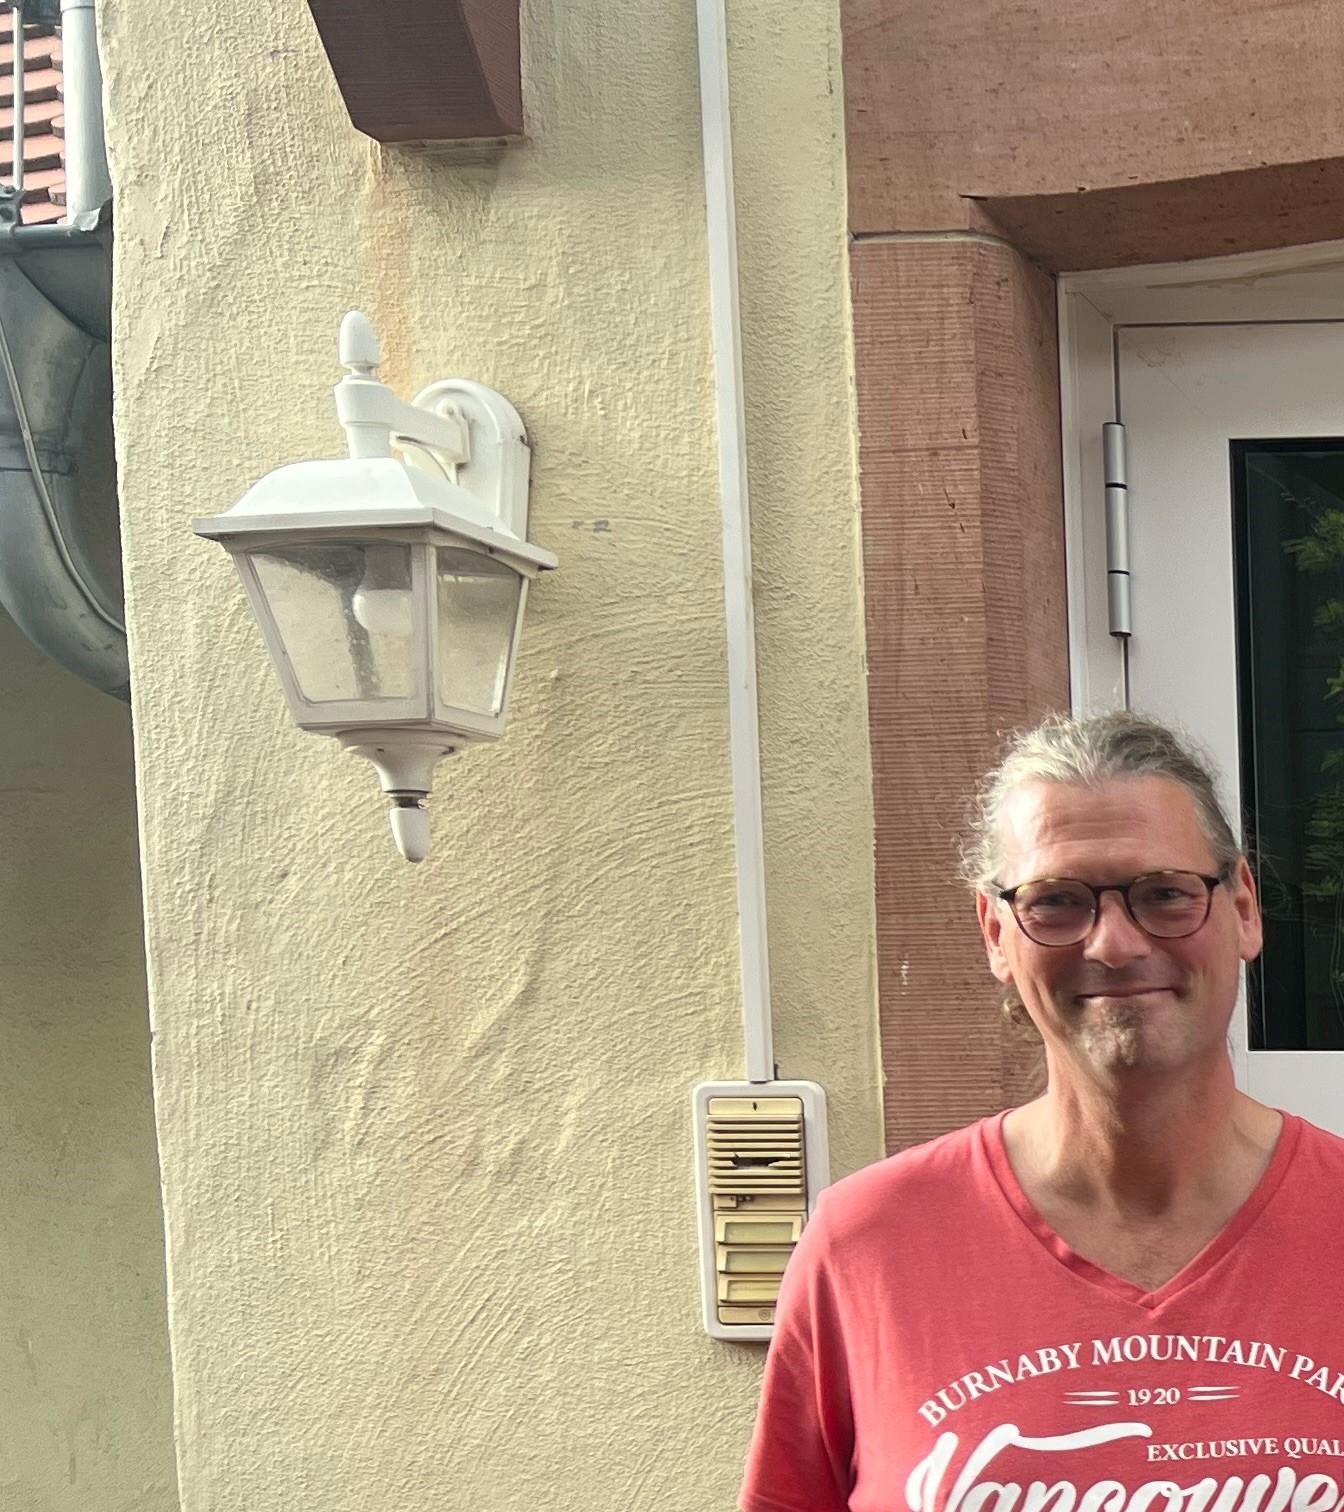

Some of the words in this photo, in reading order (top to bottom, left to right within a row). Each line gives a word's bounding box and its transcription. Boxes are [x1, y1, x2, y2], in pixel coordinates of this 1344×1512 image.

[918, 1343, 1082, 1427] BURNABY
[1091, 1335, 1287, 1371] MOUNTAIN
[1127, 1388, 1181, 1406] 1920
[1146, 1438, 1279, 1462] EXCLUSIVE
